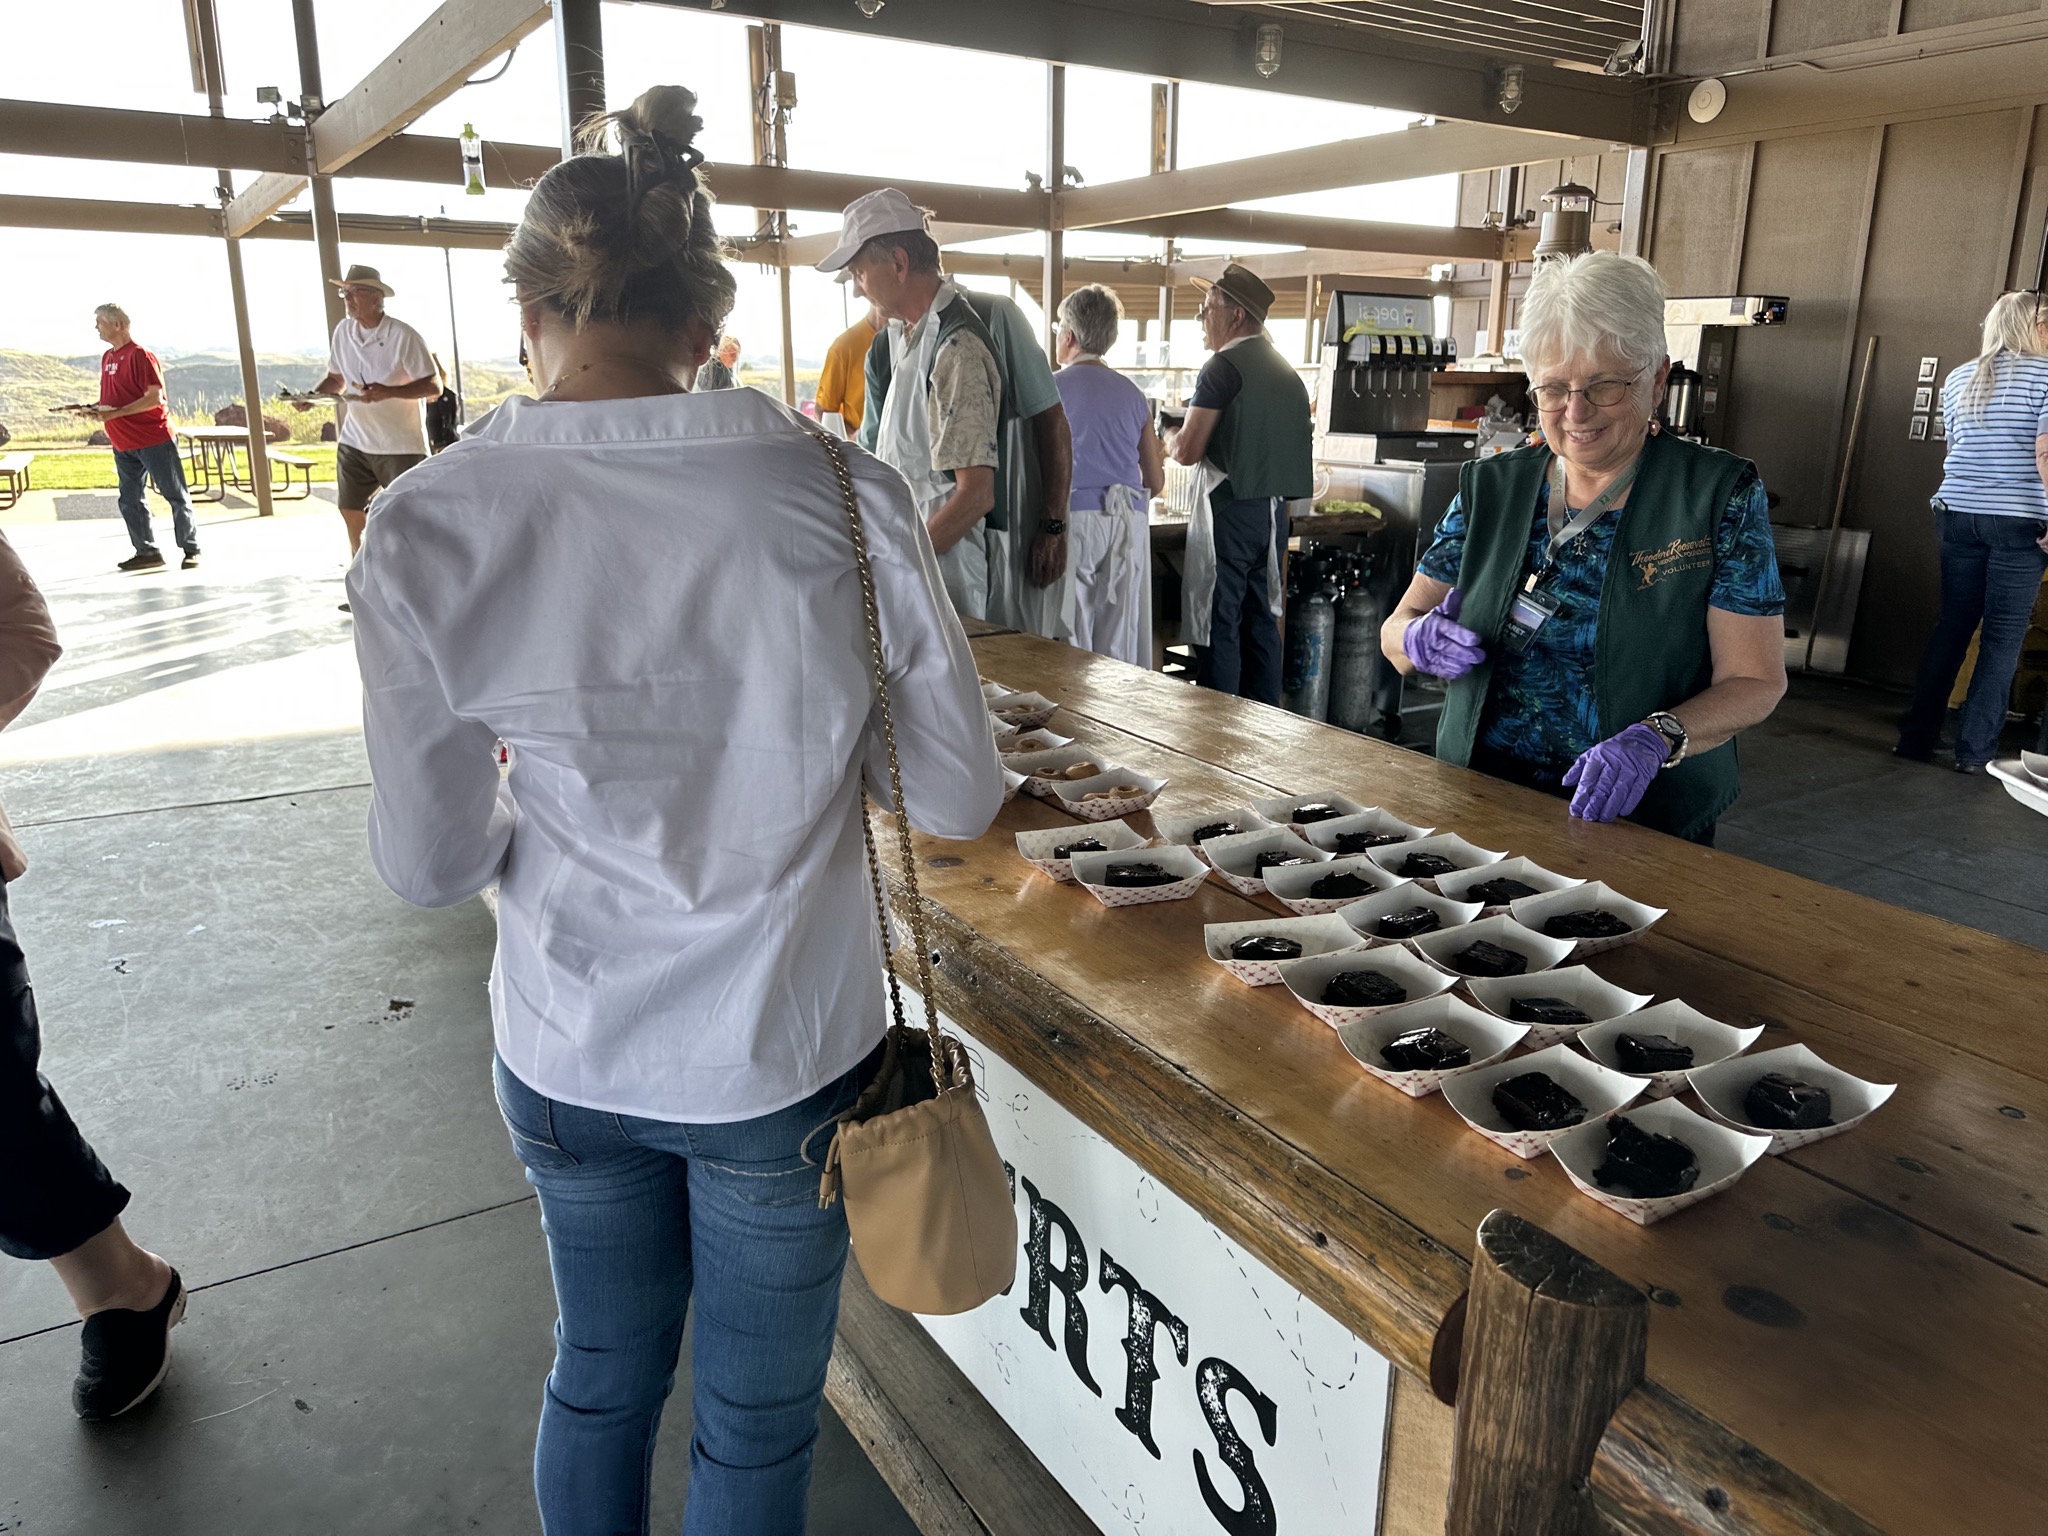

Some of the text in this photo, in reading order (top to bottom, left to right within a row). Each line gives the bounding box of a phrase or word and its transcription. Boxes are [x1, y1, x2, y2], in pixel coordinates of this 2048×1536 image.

[1629, 548, 1671, 566] Theodore
[1662, 559, 1711, 576] VOLUNTEER
[1003, 1160, 1278, 1536] RTS
